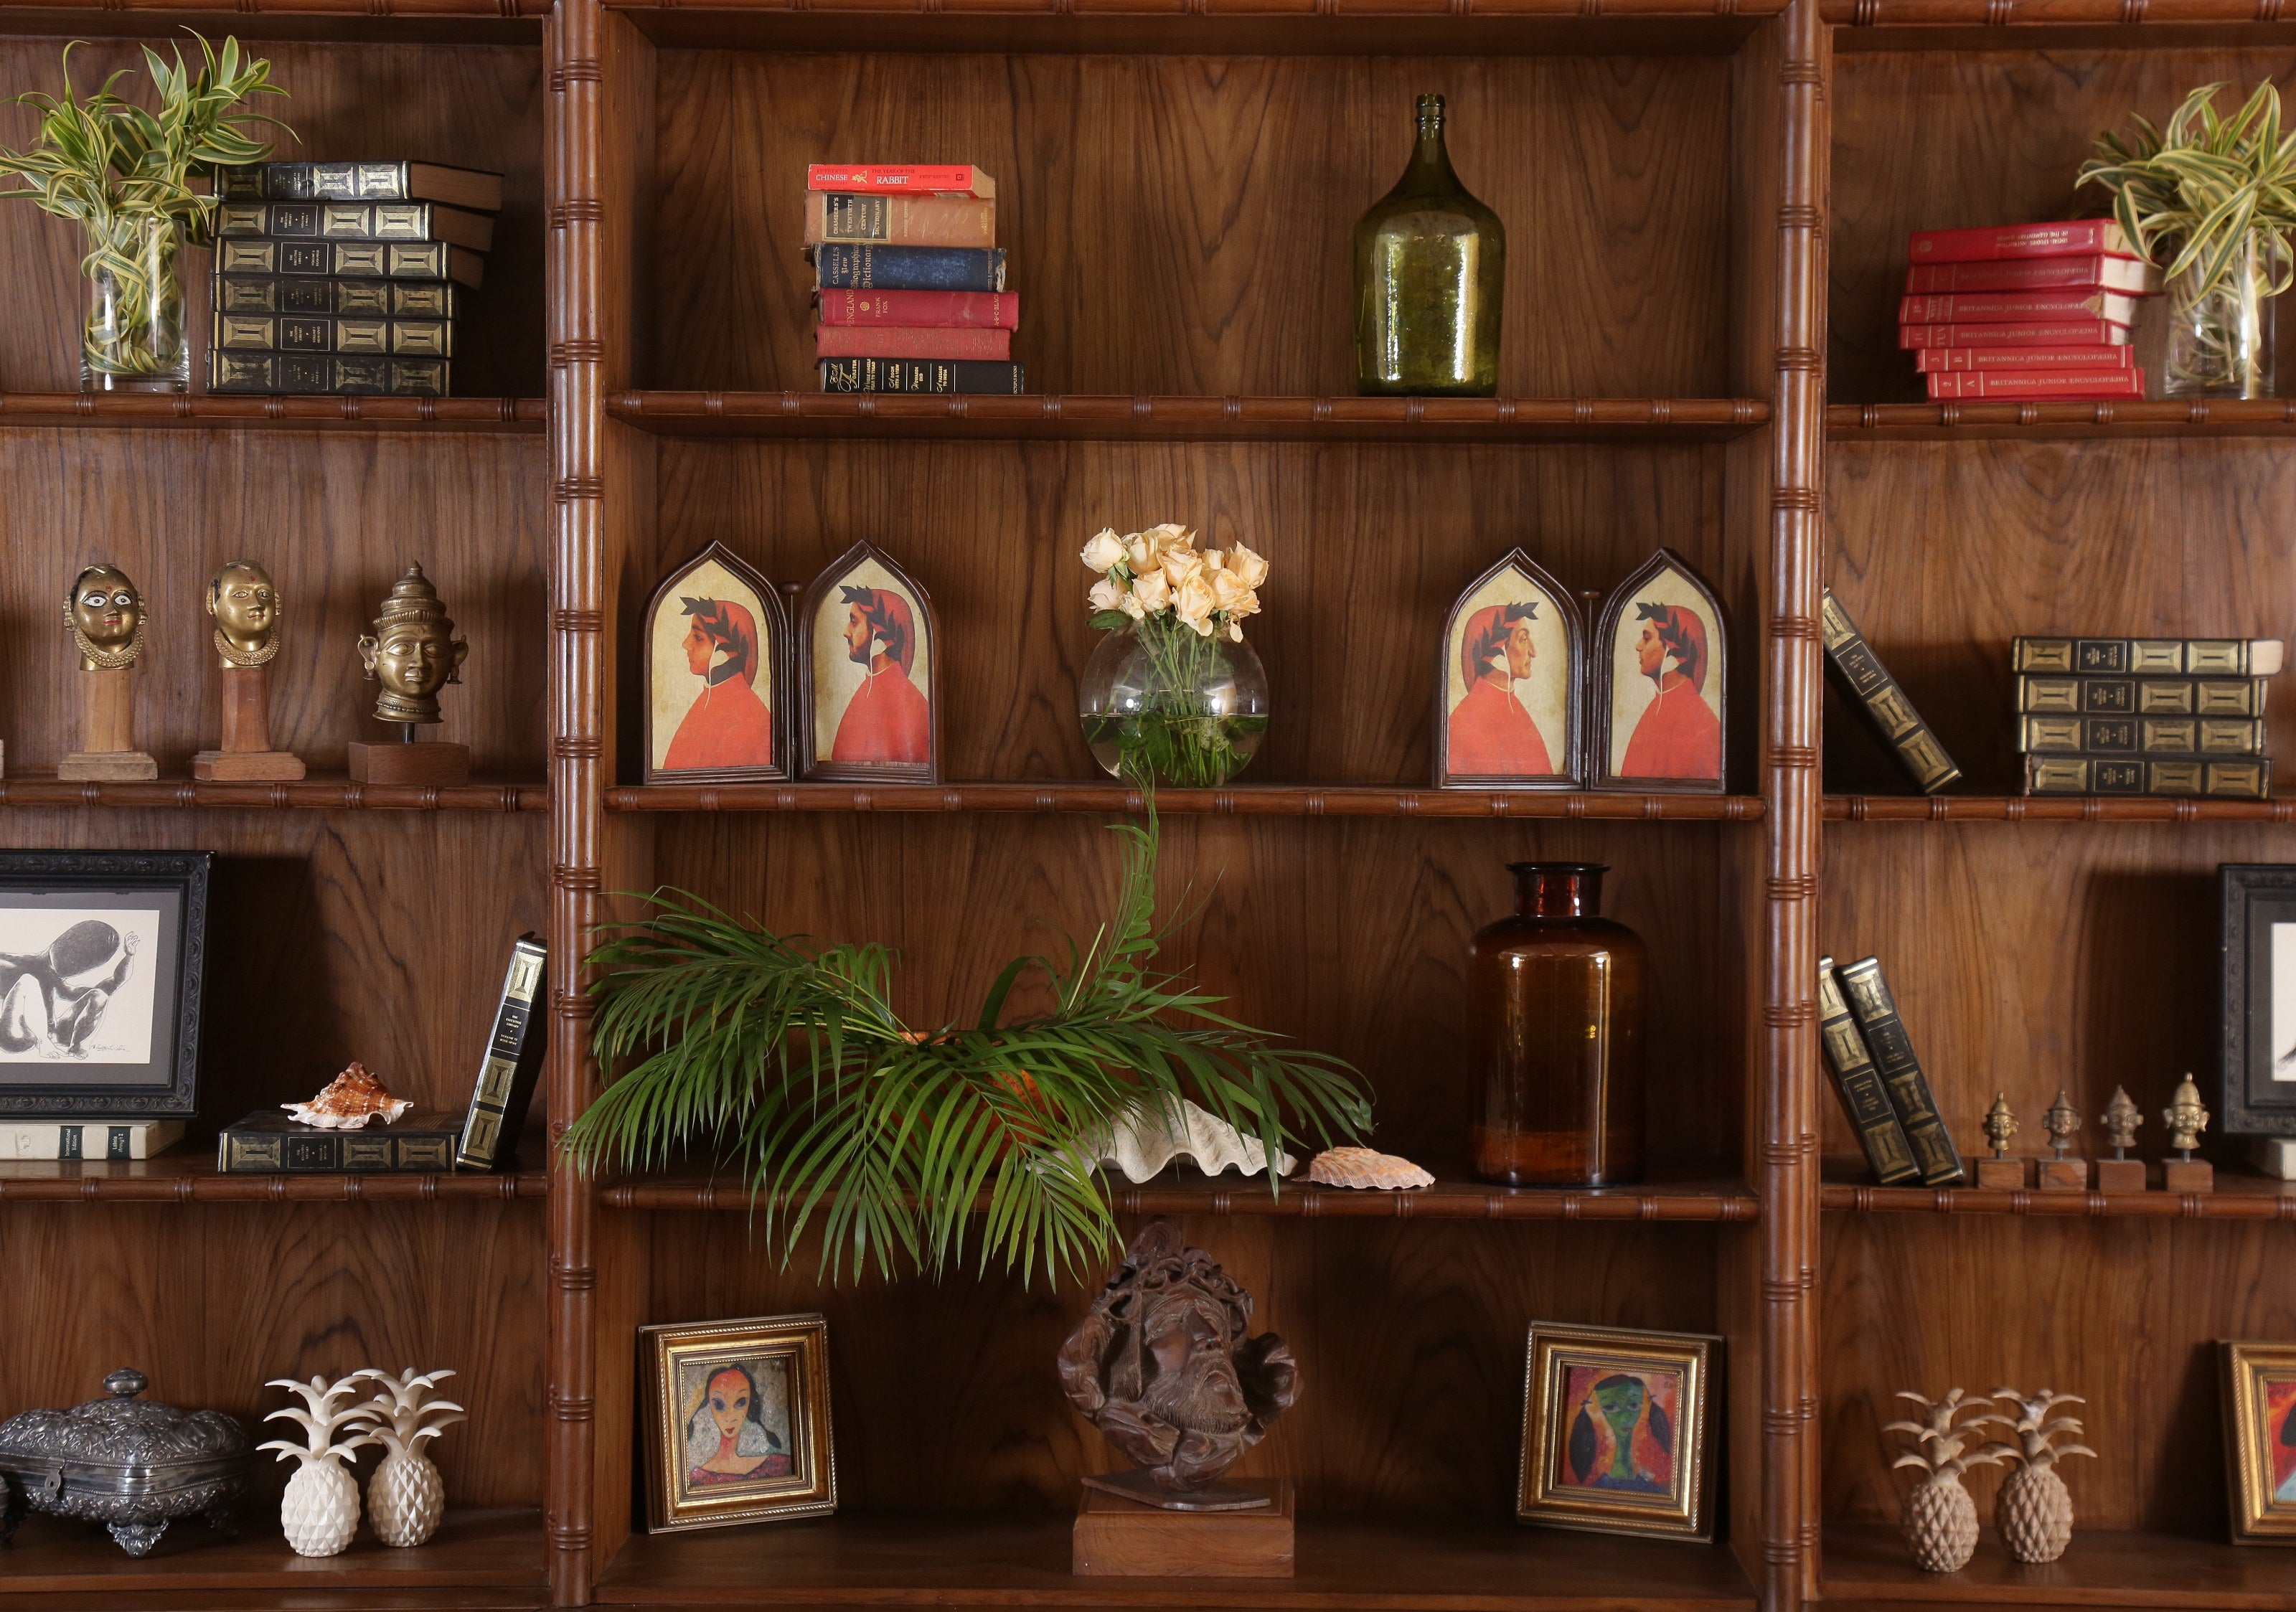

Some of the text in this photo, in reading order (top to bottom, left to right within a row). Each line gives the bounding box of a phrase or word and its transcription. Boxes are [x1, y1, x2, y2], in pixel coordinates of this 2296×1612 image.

[877, 176, 908, 184] RABBIT
[2005, 304, 2033, 313] JUNIOR
[2008, 330, 2036, 339] JUNIOR
[837, 359, 857, 392] FORSTER
